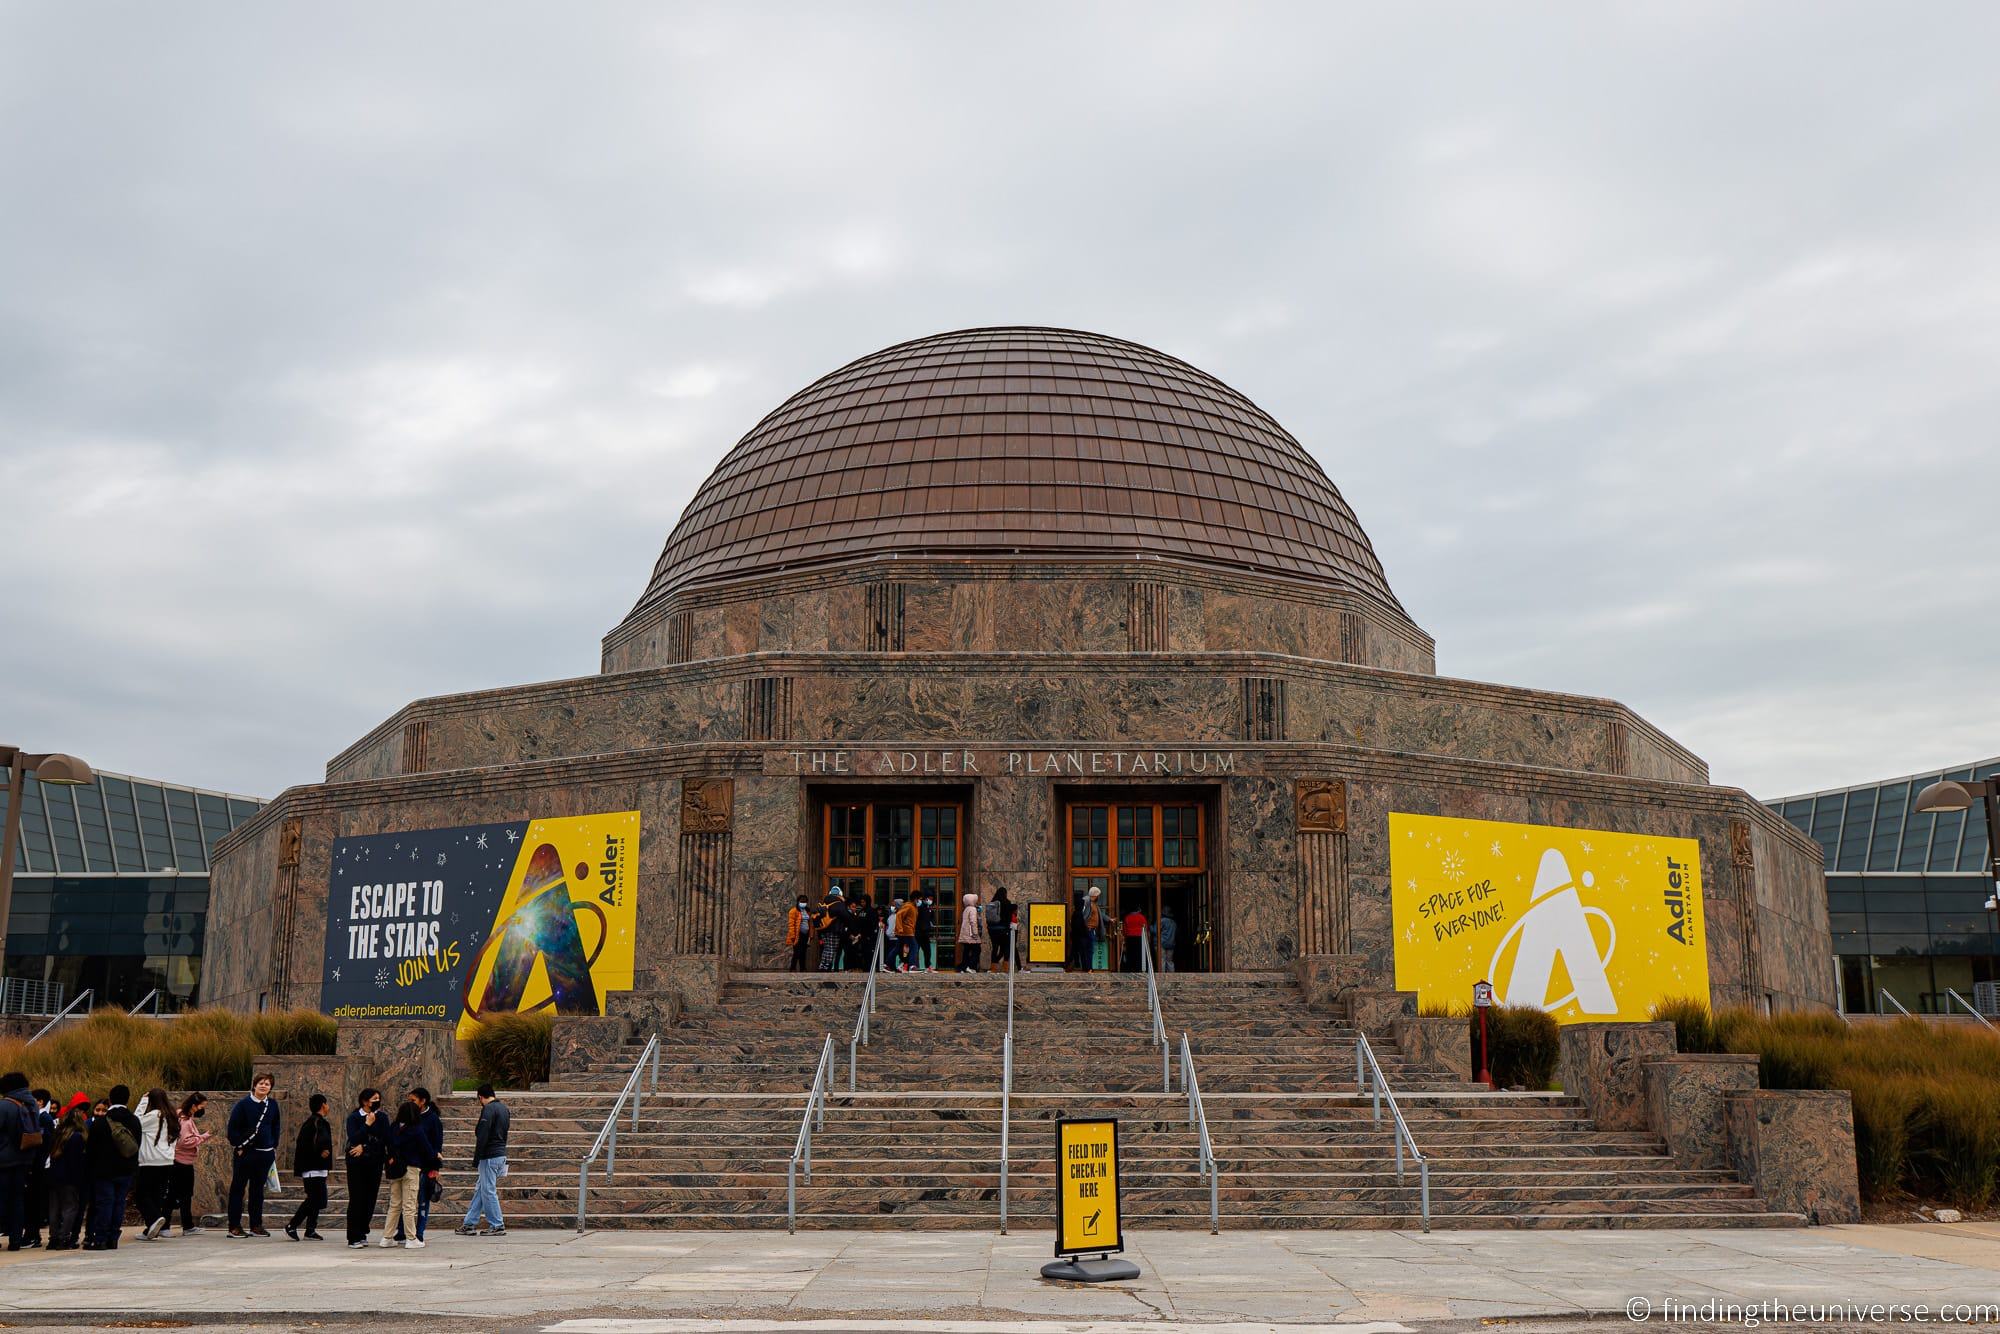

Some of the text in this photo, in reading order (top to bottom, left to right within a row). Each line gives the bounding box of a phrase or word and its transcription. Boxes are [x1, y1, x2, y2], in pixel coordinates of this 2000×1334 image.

[790, 751, 1237, 773] THE ADLER PLANETARIUM
[599, 834, 619, 906] Adler
[617, 837, 625, 907] PLANETARIUM
[350, 880, 443, 919] ESCAPE TO
[1418, 879, 1497, 919] SPACE FOR
[1664, 856, 1686, 945] Adler
[1685, 863, 1695, 946] PLANETARIUM
[348, 921, 440, 959] THE STARS
[1033, 925, 1062, 937] CLOSED
[1433, 901, 1507, 942] EVERYONE!
[395, 940, 461, 987] JOIN US
[333, 1003, 446, 1019] adlerplanetarium.org
[1068, 1143, 1108, 1159] FIELD TRIP
[1070, 1162, 1107, 1179] CHECK-IN
[1079, 1182, 1099, 1198] HERE
